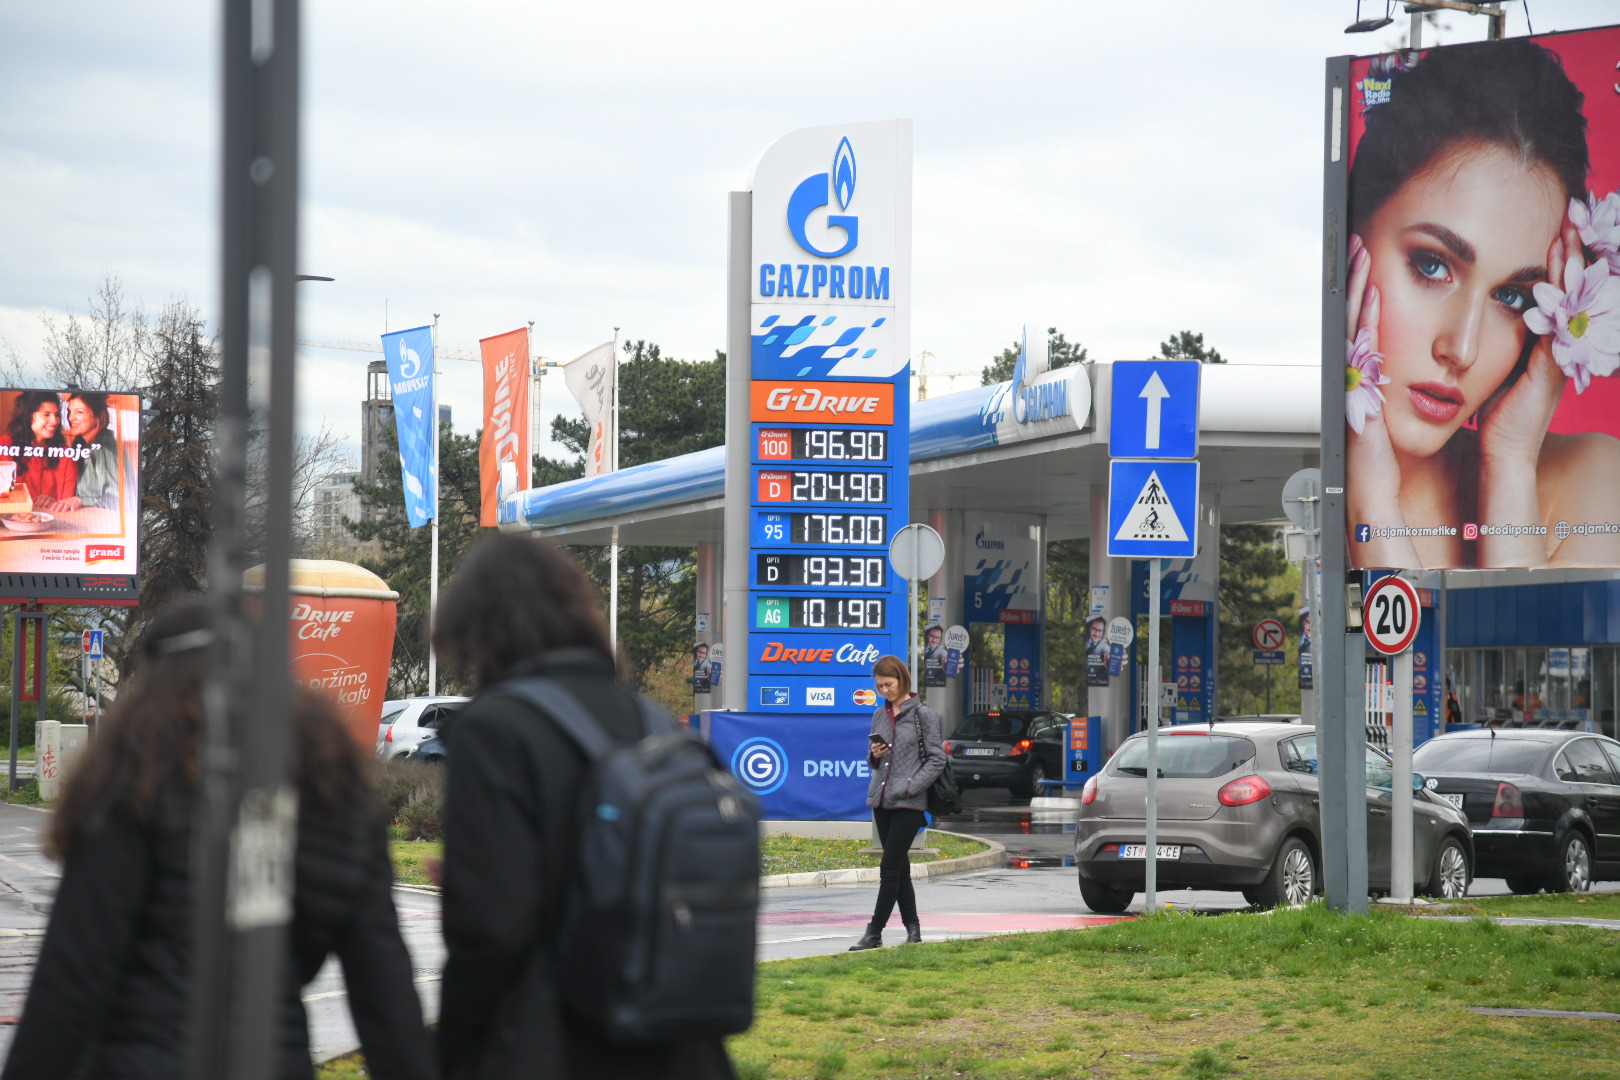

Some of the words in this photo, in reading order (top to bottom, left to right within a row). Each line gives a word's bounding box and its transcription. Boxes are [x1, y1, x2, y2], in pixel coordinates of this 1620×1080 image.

[1363, 78, 1392, 90] Naxi
[1365, 89, 1391, 99] Radio
[760, 263, 890, 299] GAZPROM
[23, 446, 44, 457] za
[762, 440, 788, 455] 100
[805, 430, 884, 460] 196.90
[769, 482, 781, 498] D
[793, 472, 883, 502] 204.90
[764, 525, 783, 540] 95
[804, 514, 883, 544] 176.00
[1480, 524, 1547, 537] @dodirpariza
[89, 547, 121, 559] grand
[767, 566, 779, 581] D
[803, 557, 882, 587] 193.30
[974, 591, 983, 609] 5
[291, 604, 355, 625] DRIVE
[764, 609, 781, 624] AG
[803, 599, 881, 628] 101.90
[1376, 594, 1406, 635] 20
[297, 621, 342, 642] Cafe
[760, 642, 835, 665] DRIVE
[836, 643, 880, 666] Cafe
[309, 671, 368, 693] pržimo
[337, 684, 371, 705] kafu
[809, 692, 834, 701] VISA
[1074, 730, 1085, 738] 100
[1076, 740, 1082, 748] D
[1076, 763, 1082, 771] D
[1126, 846, 1139, 857] ST
